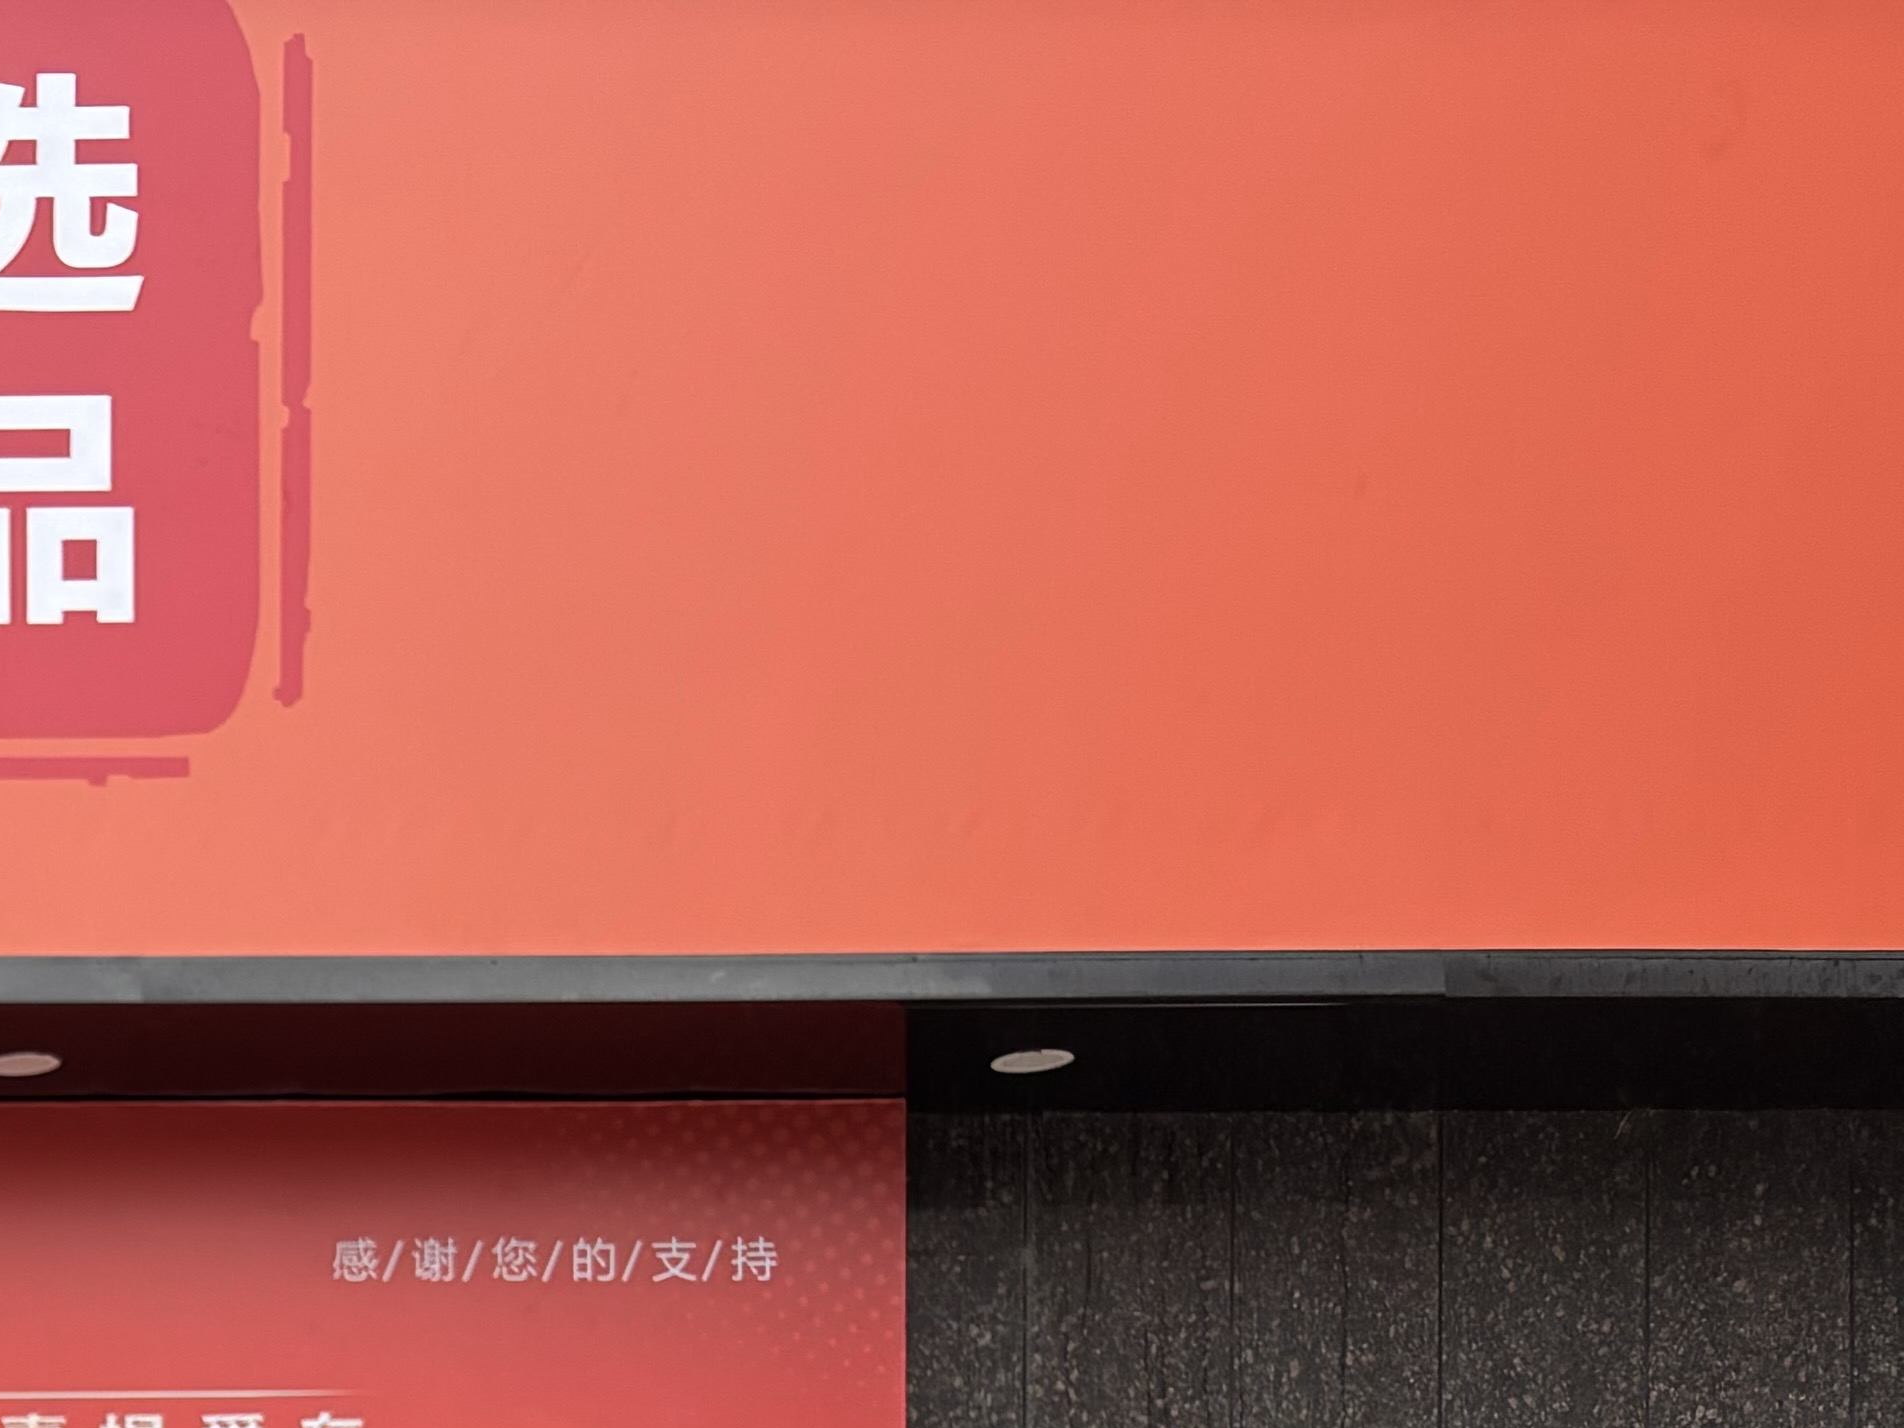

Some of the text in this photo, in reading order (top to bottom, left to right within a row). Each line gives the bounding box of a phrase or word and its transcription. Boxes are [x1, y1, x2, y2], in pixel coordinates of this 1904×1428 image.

[331, 1235, 778, 1284] 感/谢/您/的/支/持
